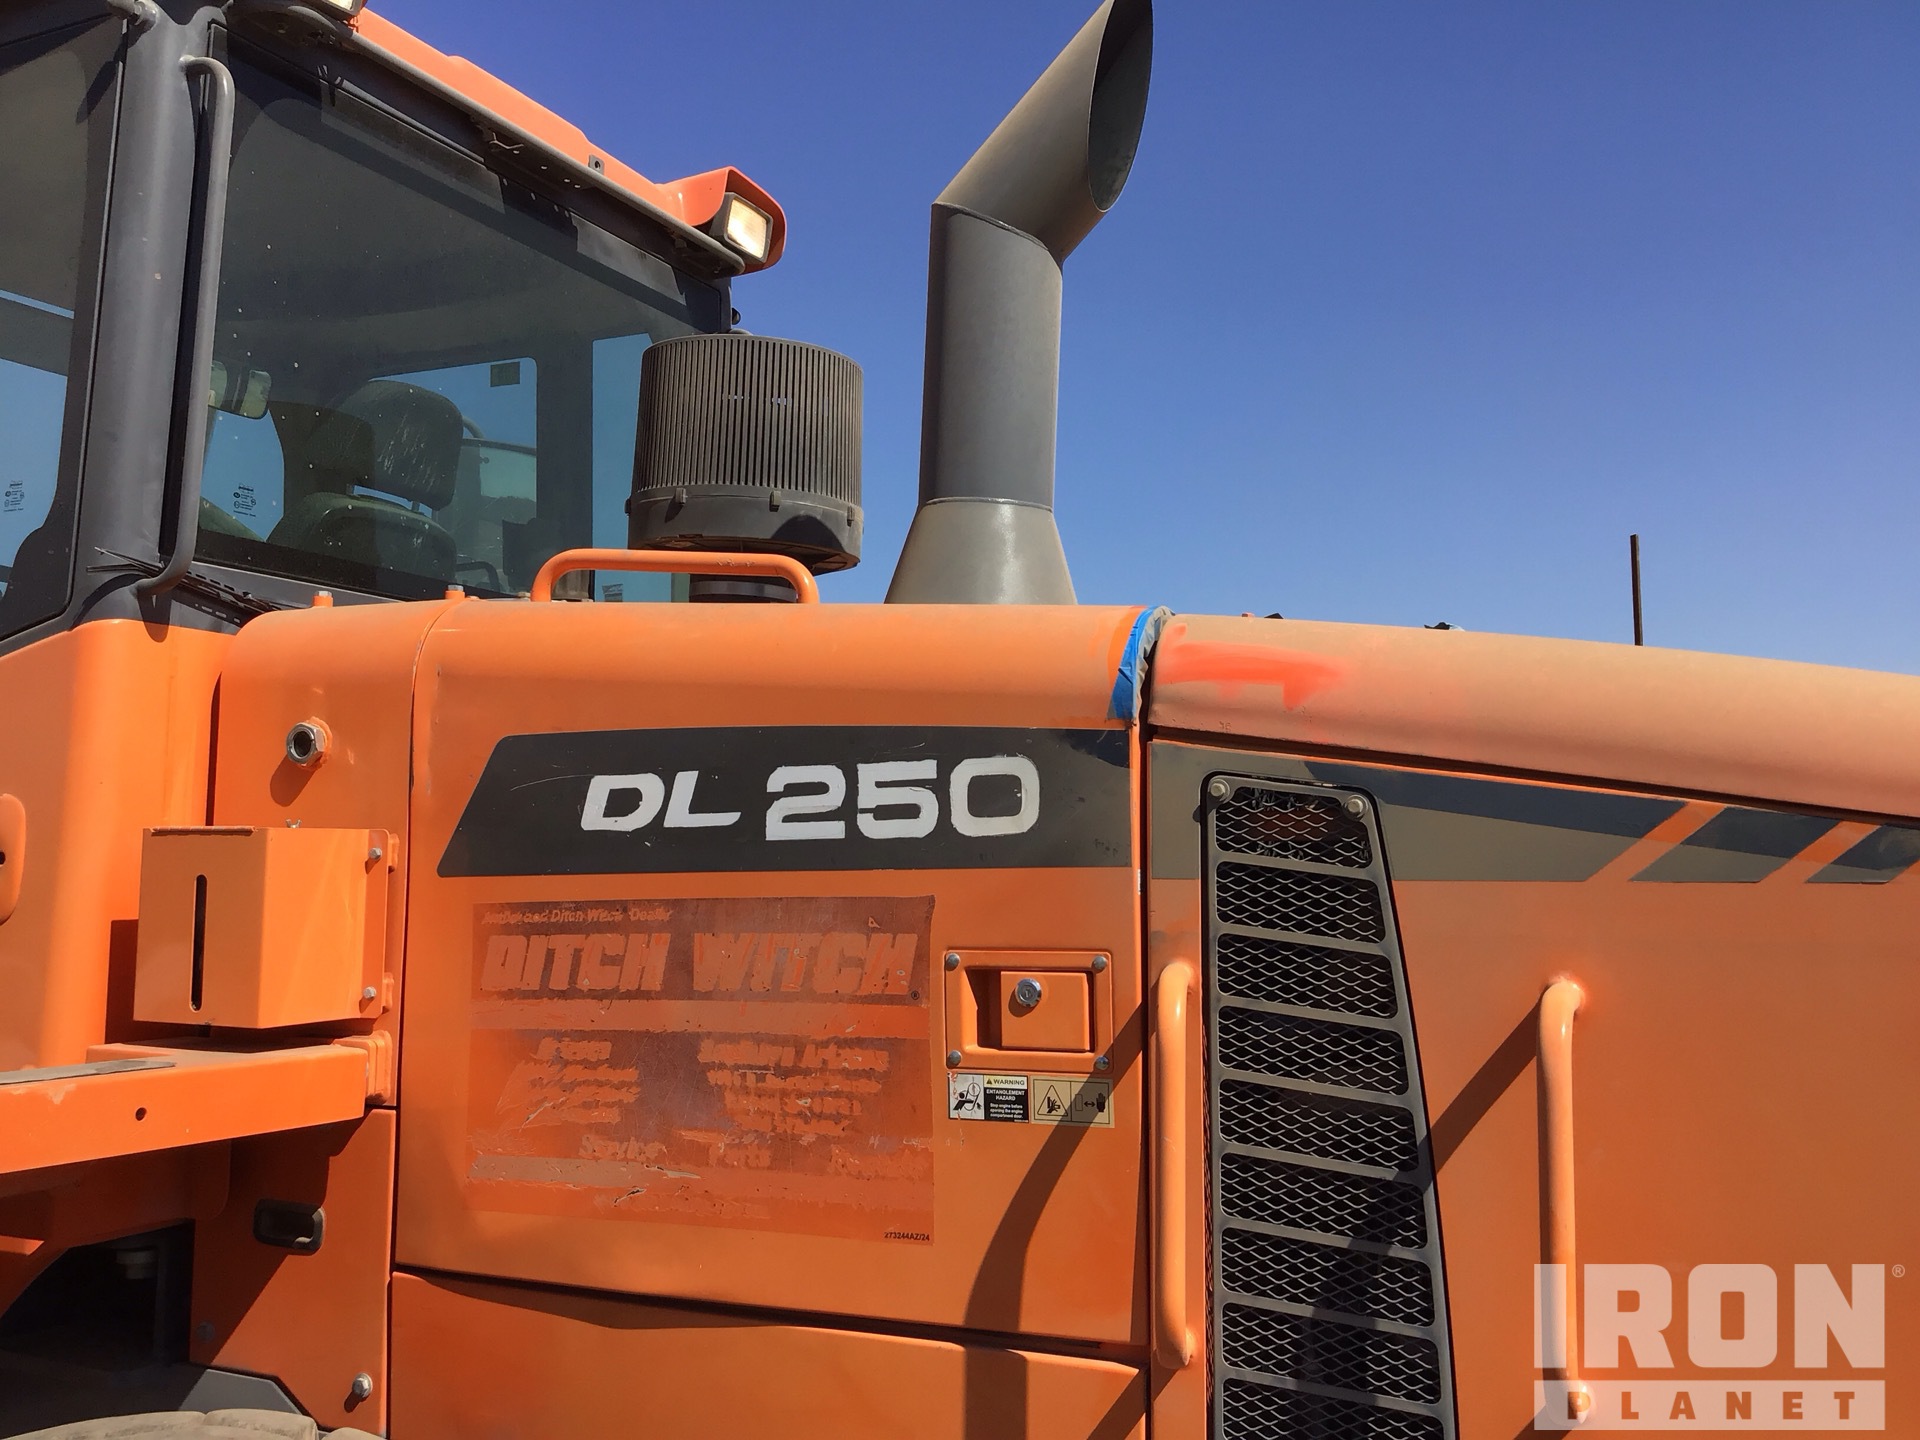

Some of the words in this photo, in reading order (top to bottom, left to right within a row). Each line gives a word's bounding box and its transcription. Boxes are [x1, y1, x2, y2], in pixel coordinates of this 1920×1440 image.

[580, 770, 741, 832] DL
[765, 756, 1040, 841] 250
[480, 933, 671, 992] DITCH
[693, 932, 919, 996] WITCH
[993, 1078, 1025, 1086] WARNING
